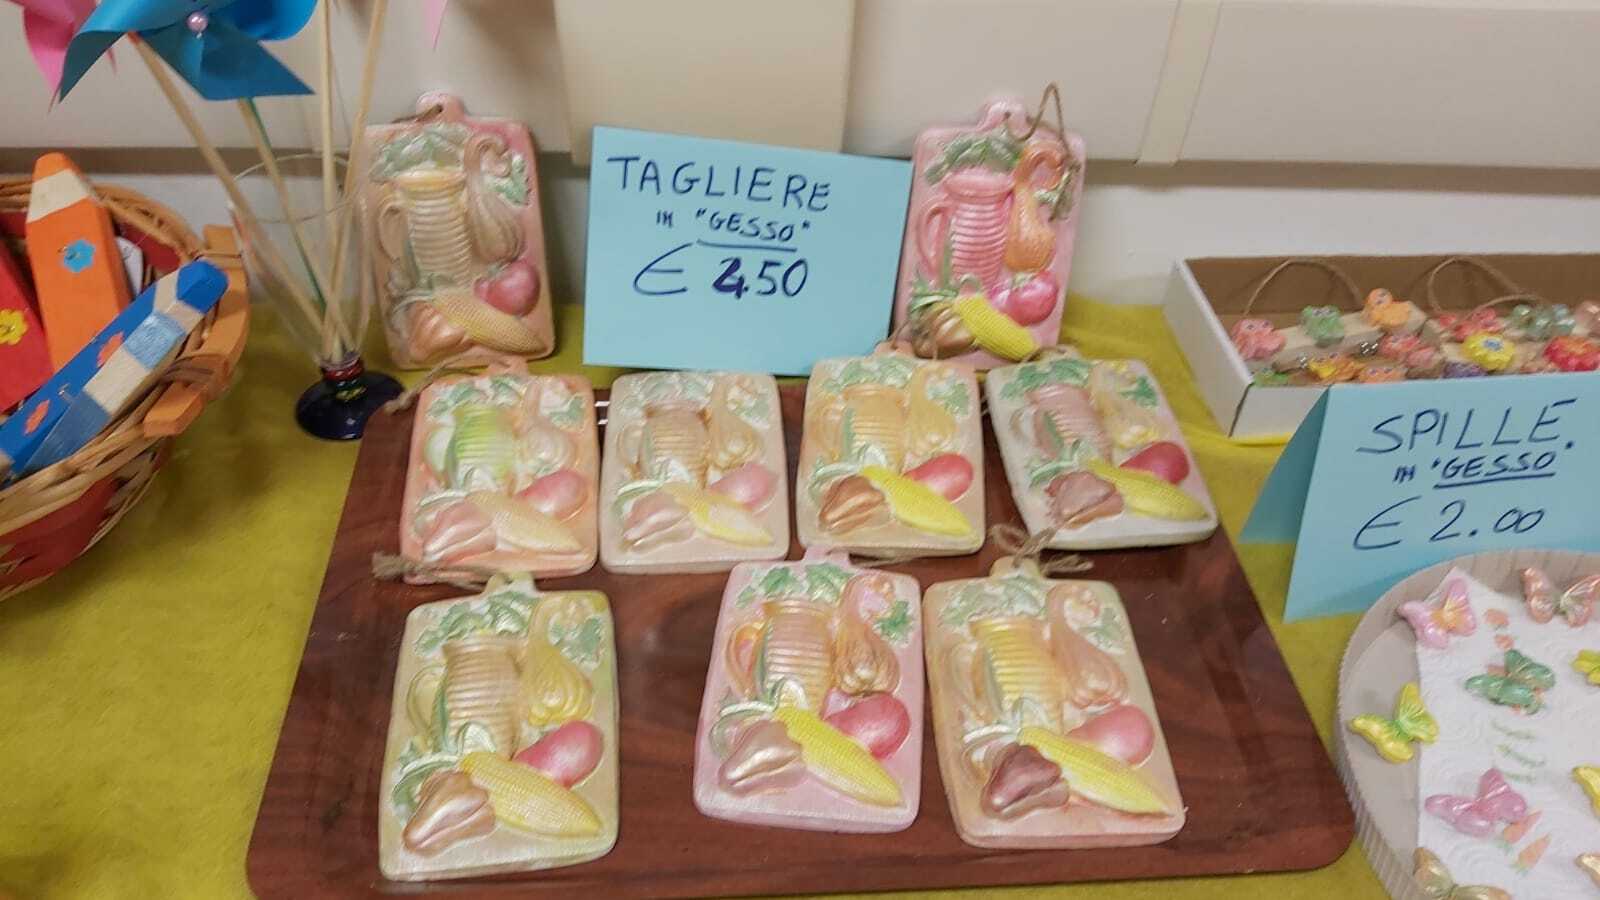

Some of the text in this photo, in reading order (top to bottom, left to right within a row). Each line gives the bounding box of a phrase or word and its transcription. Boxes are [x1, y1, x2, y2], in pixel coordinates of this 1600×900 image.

[607, 156, 831, 212] TAGLIERE
[633, 243, 694, 296] €
[1356, 398, 1577, 454] SPILLE
[1353, 496, 1545, 550] € 2.00
